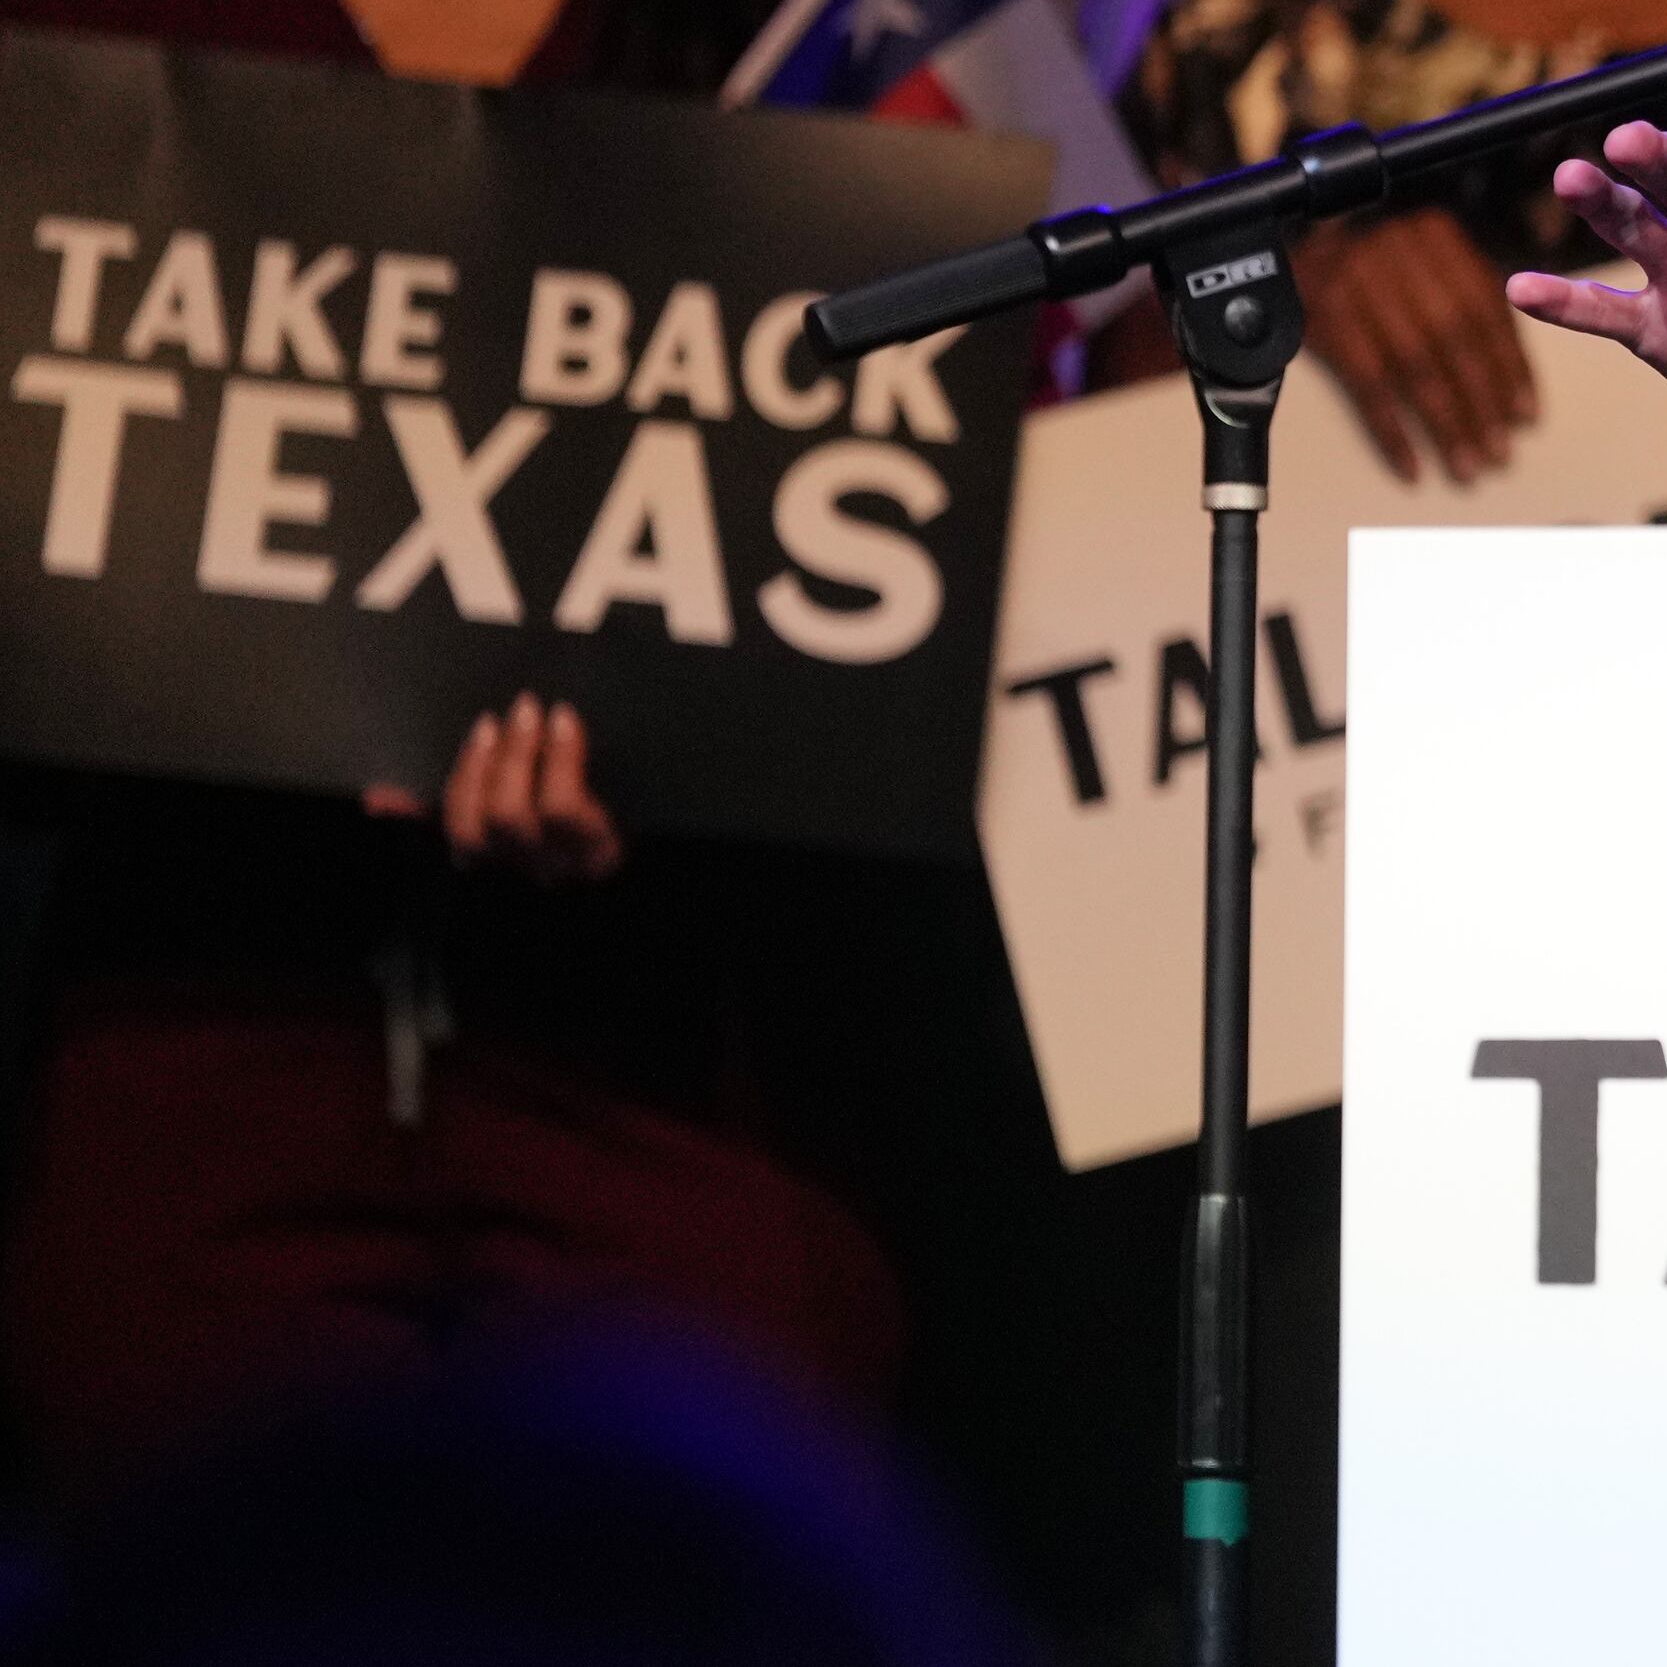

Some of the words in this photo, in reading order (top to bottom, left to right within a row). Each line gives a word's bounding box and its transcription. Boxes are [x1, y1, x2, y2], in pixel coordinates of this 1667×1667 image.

[36, 215, 457, 390] TAKE
[519, 270, 972, 443] BACK
[11, 355, 950, 664] TEXAS
